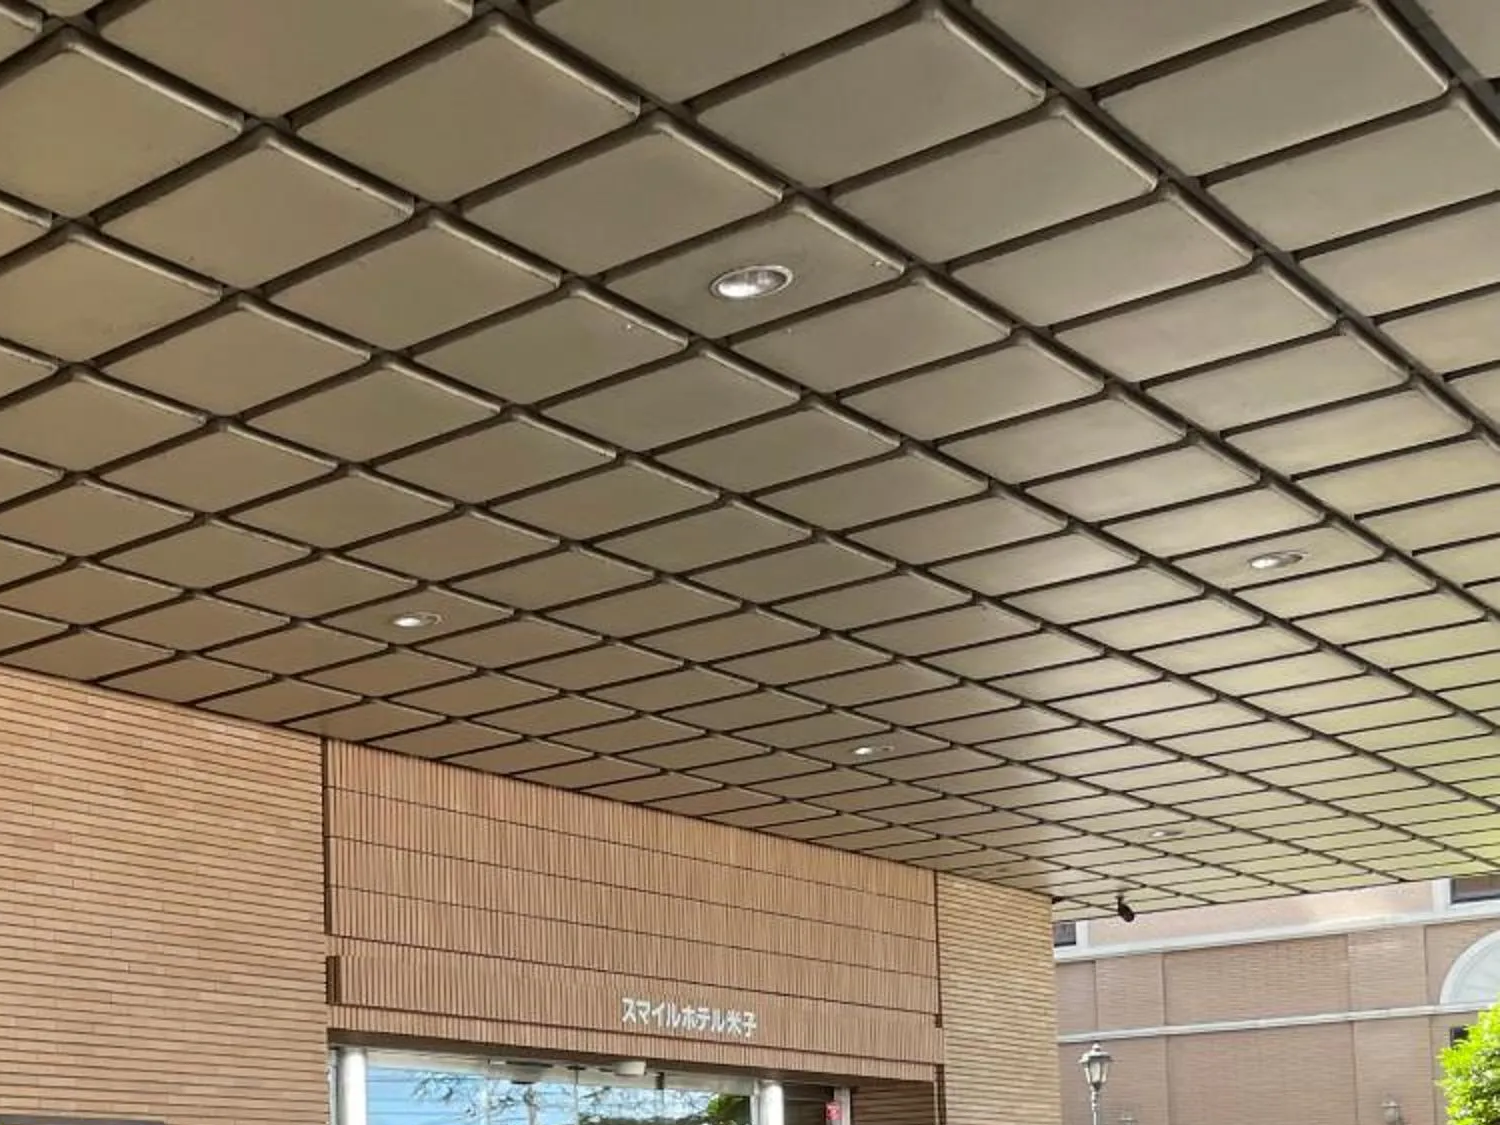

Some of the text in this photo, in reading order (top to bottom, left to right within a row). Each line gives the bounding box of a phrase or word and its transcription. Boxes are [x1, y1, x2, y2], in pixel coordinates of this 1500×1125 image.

[621, 997, 757, 1037] スマイルホテル米子
